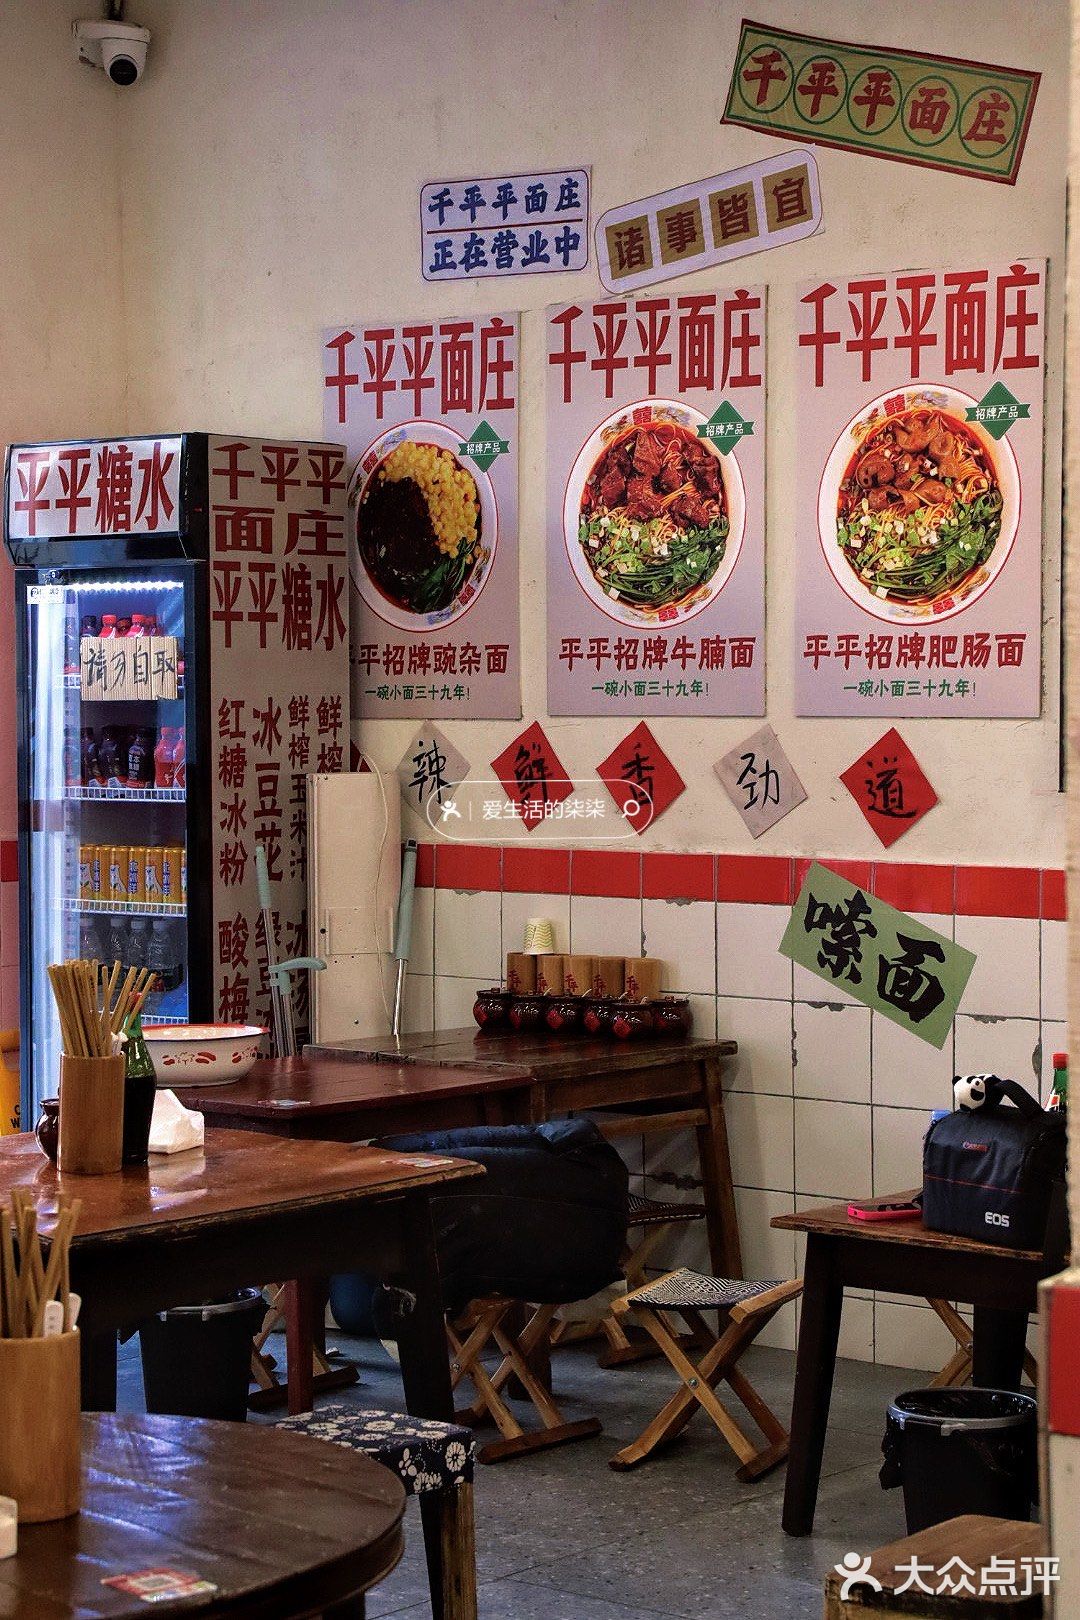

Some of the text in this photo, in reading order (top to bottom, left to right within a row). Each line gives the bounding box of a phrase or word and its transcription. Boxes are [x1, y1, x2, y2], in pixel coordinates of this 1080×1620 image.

[742, 50, 1011, 144] 千平平面庄
[427, 178, 581, 226] 千平平面庄
[613, 175, 808, 270] 诸事皆宜
[428, 226, 581, 274] 正在营业中
[549, 289, 762, 403] 千平平面庄
[799, 264, 1040, 387] 千平平面庄
[325, 317, 515, 423] 千平平面庄
[705, 422, 744, 437] 招牌产品
[975, 404, 1019, 419] 招牌产品
[212, 442, 346, 504] 千平平
[466, 442, 501, 454] 招牌产品
[14, 442, 174, 535] 平平糖水
[212, 505, 346, 557] 面庄
[212, 561, 347, 651] 平平糖水
[350, 642, 509, 676] 平招牌豌杂面
[559, 635, 756, 672] 平平招牌牛腩面
[804, 632, 1026, 671] 平平招牌肥肠面
[365, 684, 470, 700] 一碗小面三十九年!
[592, 679, 709, 697] 一碗小面三十九年!
[843, 679, 976, 698] 一碗小面三十九年!
[218, 698, 247, 886] 红糖冰粉
[252, 697, 283, 882] 冰豆花
[408, 740, 451, 803] 辣
[737, 753, 780, 810] 劲
[864, 757, 918, 820] 道
[804, 890, 946, 1024] 嗦面
[985, 1211, 1010, 1227] EOS
